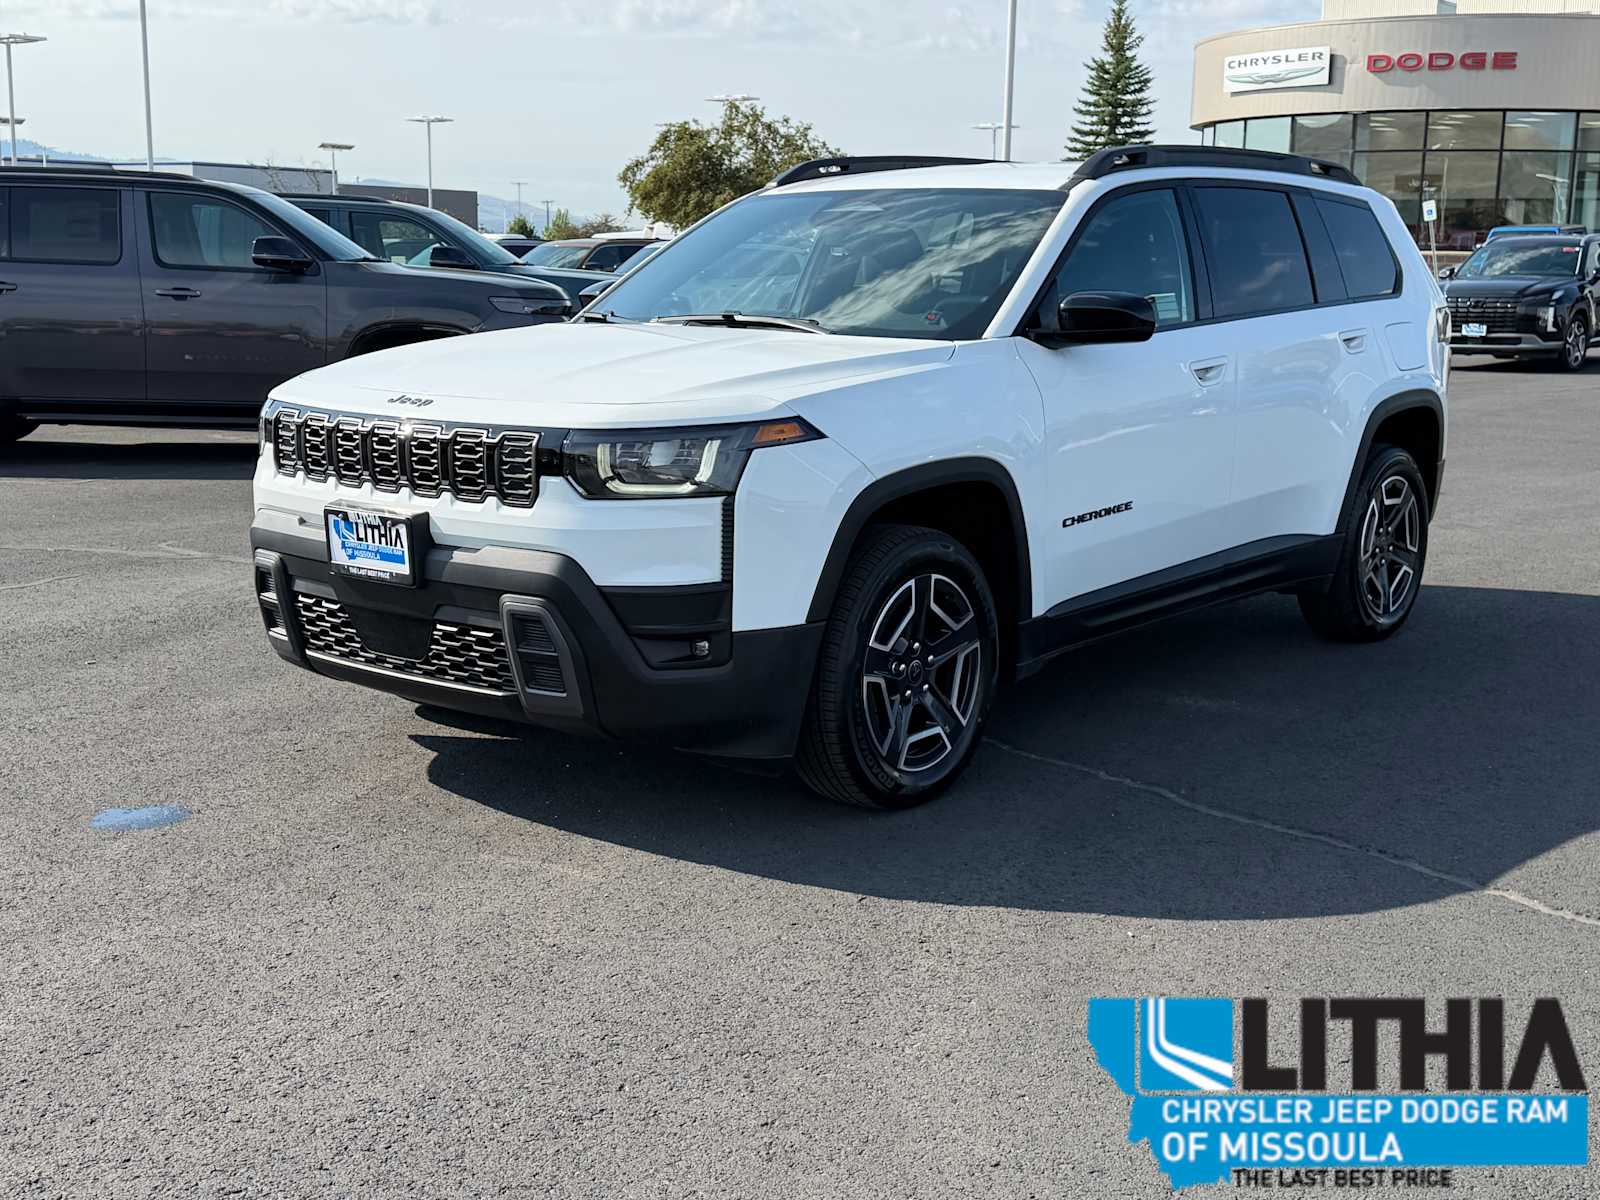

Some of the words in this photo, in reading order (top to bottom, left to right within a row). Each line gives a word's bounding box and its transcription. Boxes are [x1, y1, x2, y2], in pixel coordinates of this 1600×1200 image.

[1227, 52, 1324, 70] CHRYSLER
[1366, 52, 1518, 73] DODGE
[387, 395, 434, 407] Jeep
[1062, 501, 1133, 528] CHEROKEE
[355, 521, 404, 549] LITHIA
[346, 548, 353, 556] OF
[354, 549, 380, 560] MISSOULA
